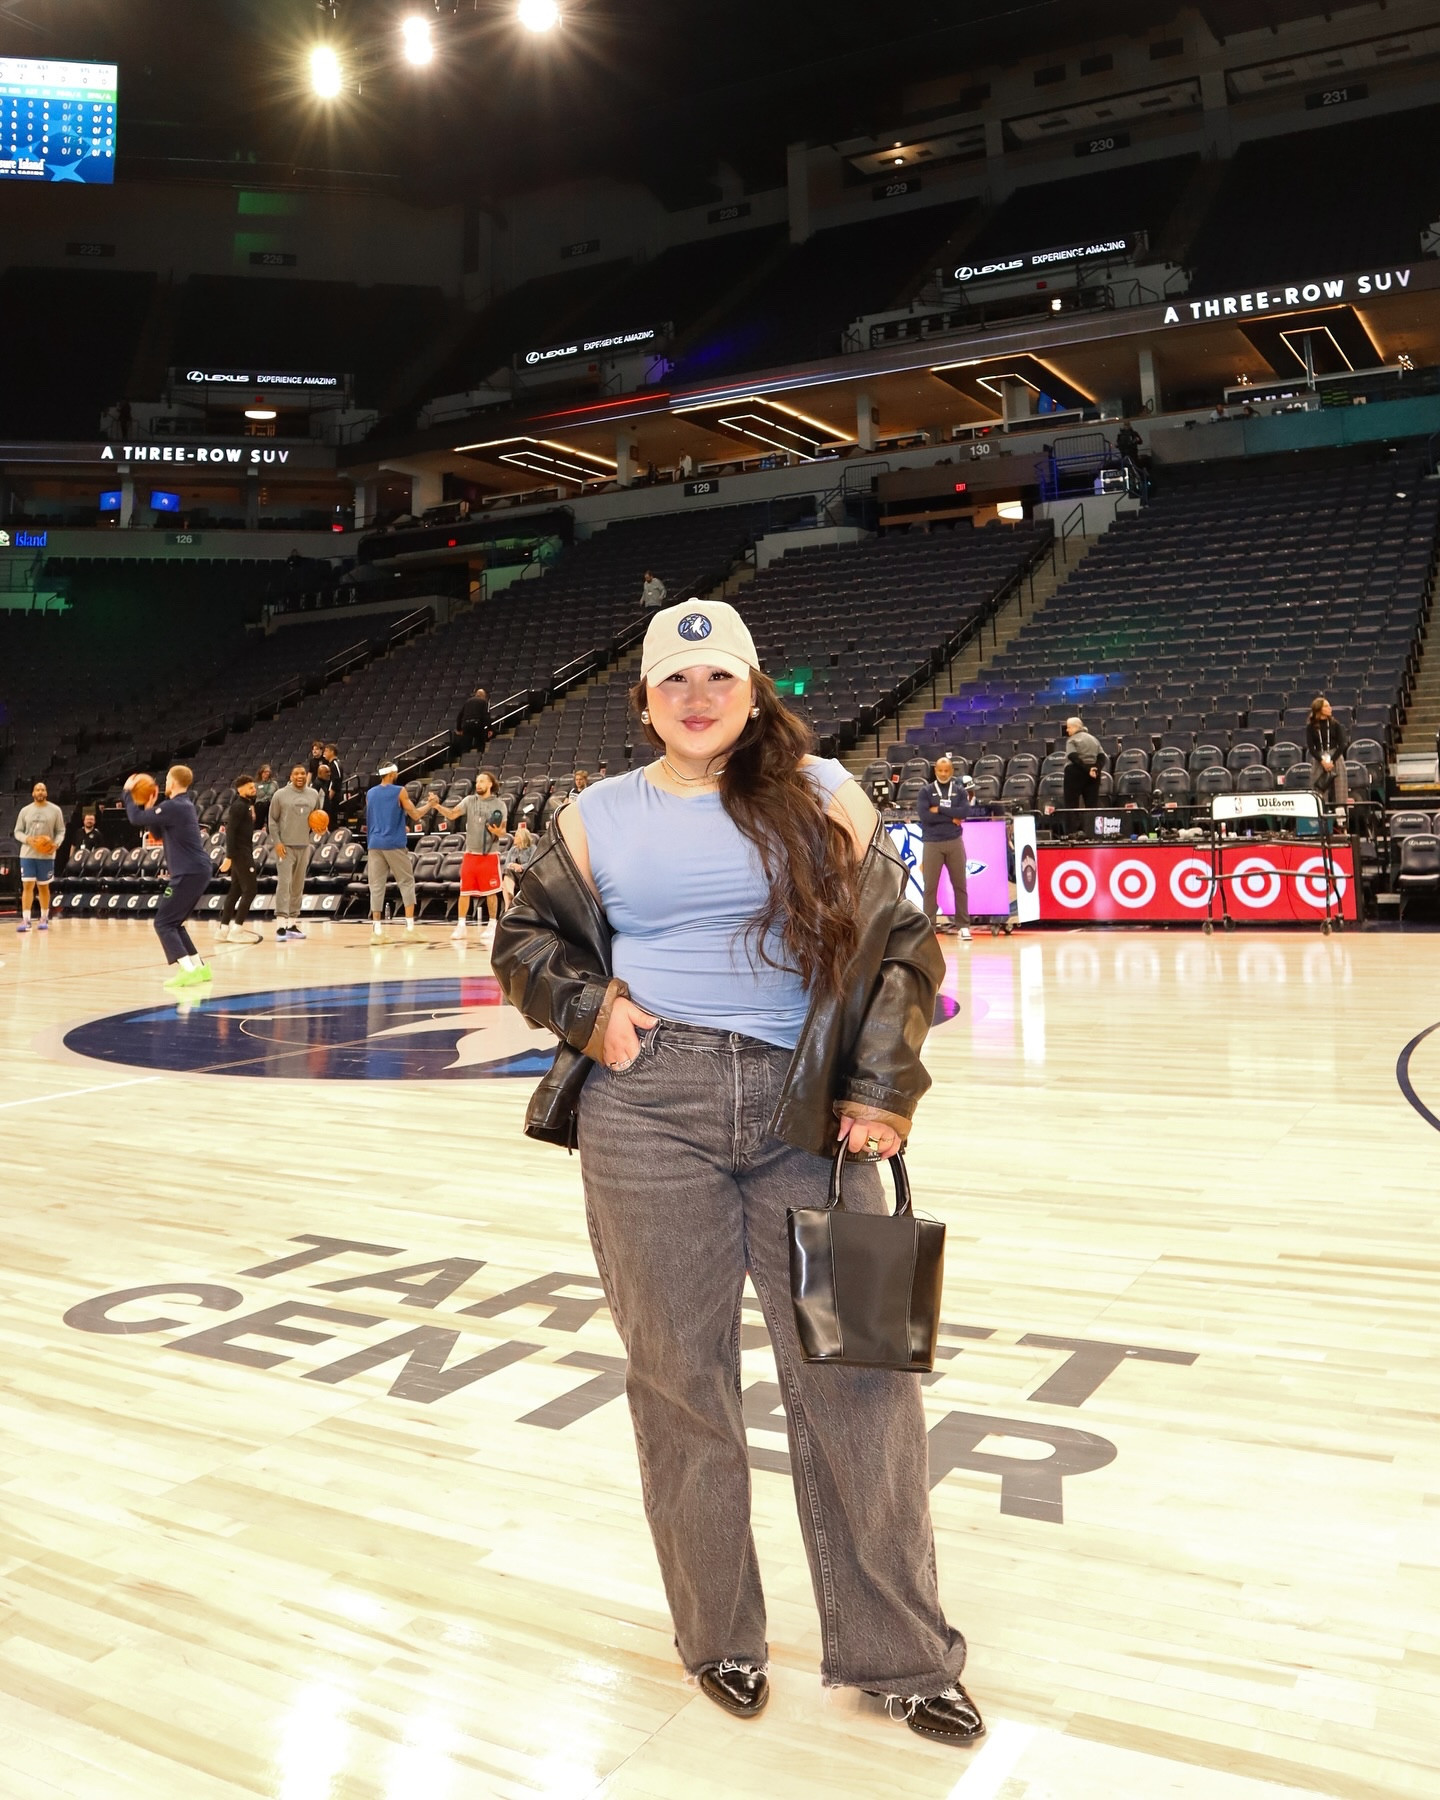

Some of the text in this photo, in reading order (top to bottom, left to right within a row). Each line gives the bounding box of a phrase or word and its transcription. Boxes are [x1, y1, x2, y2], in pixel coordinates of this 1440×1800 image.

[1322, 89, 1348, 105] 231
[1090, 138, 1114, 153] 230
[886, 183, 907, 197] 229
[974, 260, 1024, 275] LEXUS
[1032, 247, 1085, 265] EXPERIENCE
[1164, 270, 1410, 323] A THREE-ROW SUV
[540, 346, 578, 359] LEXUS
[205, 374, 249, 382] LEXUS
[257, 375, 302, 384] EXPERIENCE
[101, 446, 289, 463] A THREE-ROW SUV
[970, 444, 990, 455] 130
[693, 482, 710, 494] 129
[15, 530, 48, 547] Island
[176, 535, 192, 544] 126
[1257, 797, 1295, 807] Wilson
[211, 833, 219, 844] G
[253, 832, 261, 842] G
[334, 831, 344, 841] G
[74, 850, 84, 861] G
[95, 849, 104, 860] G
[112, 849, 121, 860] G
[131, 849, 141, 860] G
[151, 849, 160, 860] G
[211, 848, 220, 859] G
[253, 848, 262, 859] G
[321, 846, 331, 858] G
[345, 846, 355, 857] G
[52, 895, 64, 906] G
[71, 894, 83, 906] G
[90, 894, 101, 906] G
[108, 895, 120, 907] G
[127, 896, 139, 908] G
[148, 895, 159, 907] G
[209, 896, 220, 908] G
[253, 897, 264, 908] G
[302, 896, 312, 909] G
[322, 896, 334, 909] G
